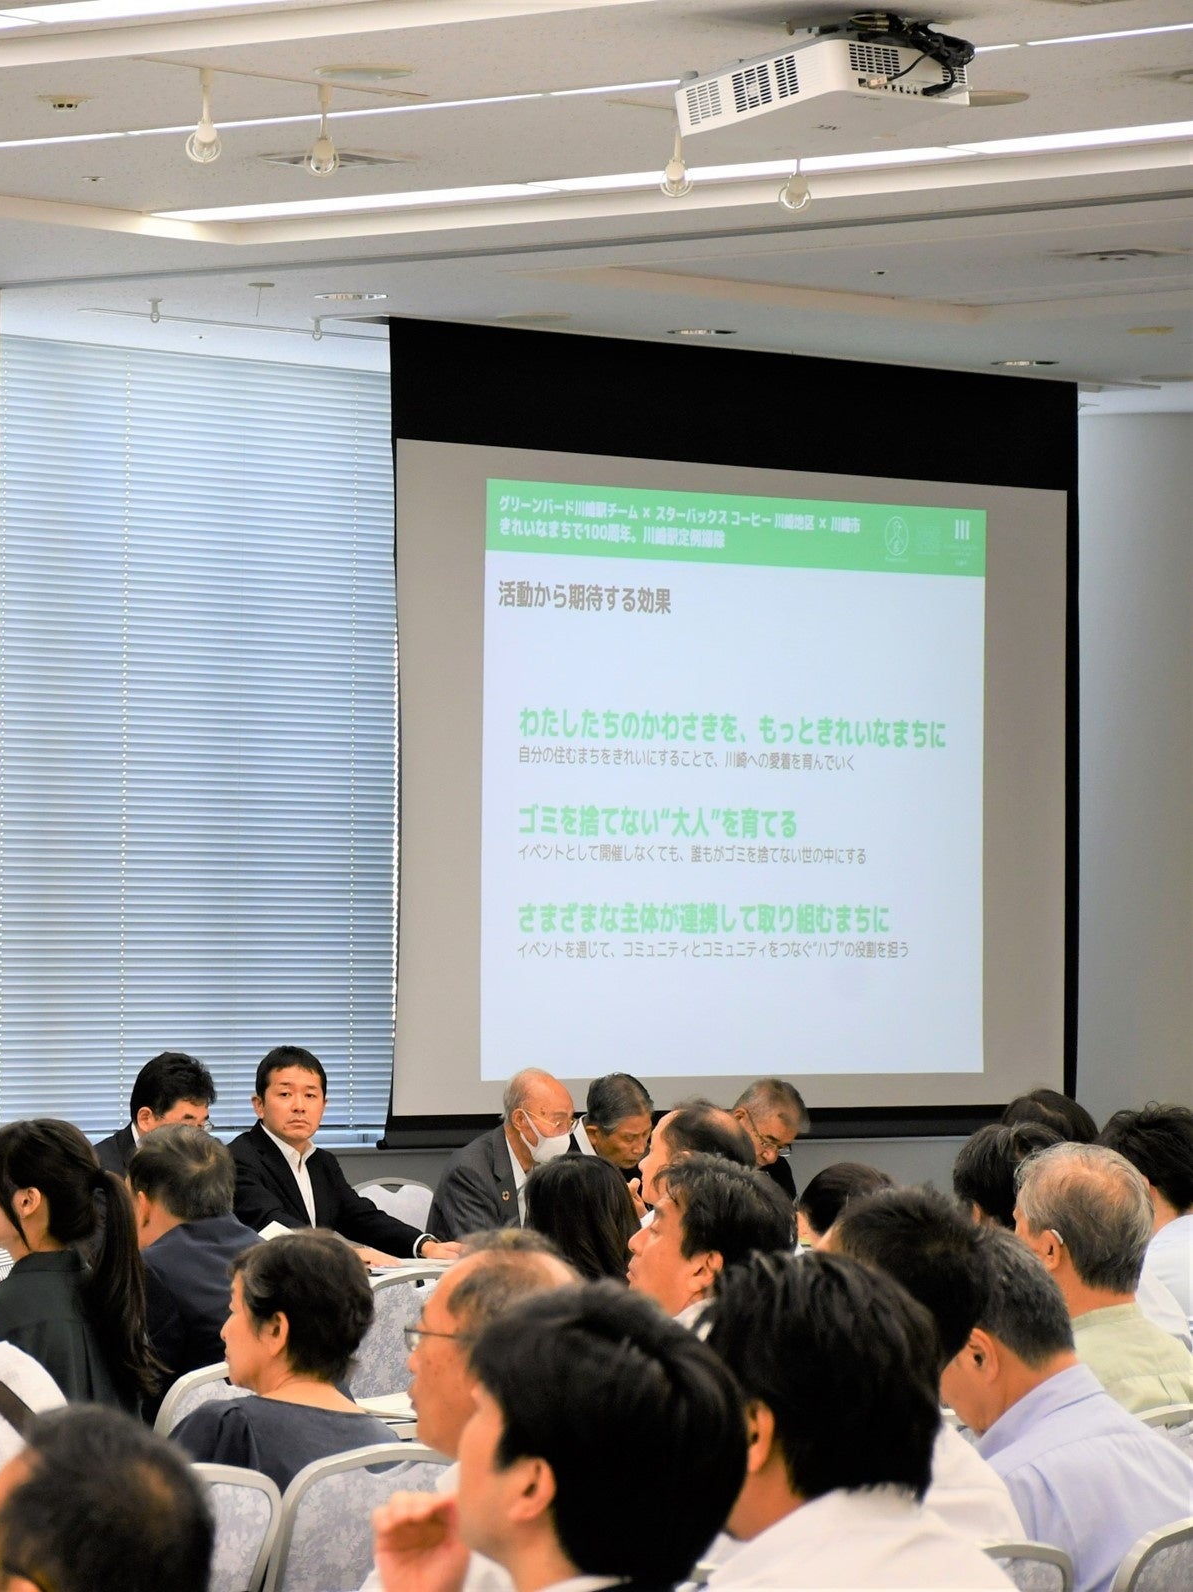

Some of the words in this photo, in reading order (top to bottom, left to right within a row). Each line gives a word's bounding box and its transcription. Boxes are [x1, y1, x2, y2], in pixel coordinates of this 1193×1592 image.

[656, 505, 728, 525] スターバックス
[731, 510, 771, 528] コーヒー
[498, 580, 671, 615] 活動から期待する効果
[519, 707, 946, 749] わたしたちのかわさきを、もっときれいなまちに
[518, 746, 855, 772] 自分の住むまちをきれいにすることで、川崎への愛着を育んでいく
[517, 844, 867, 866] イベントとして開催しなくても、誰もがゴミを捨てない世の中にする
[518, 902, 889, 935] さまざまな主体が連携して取り組むまちに
